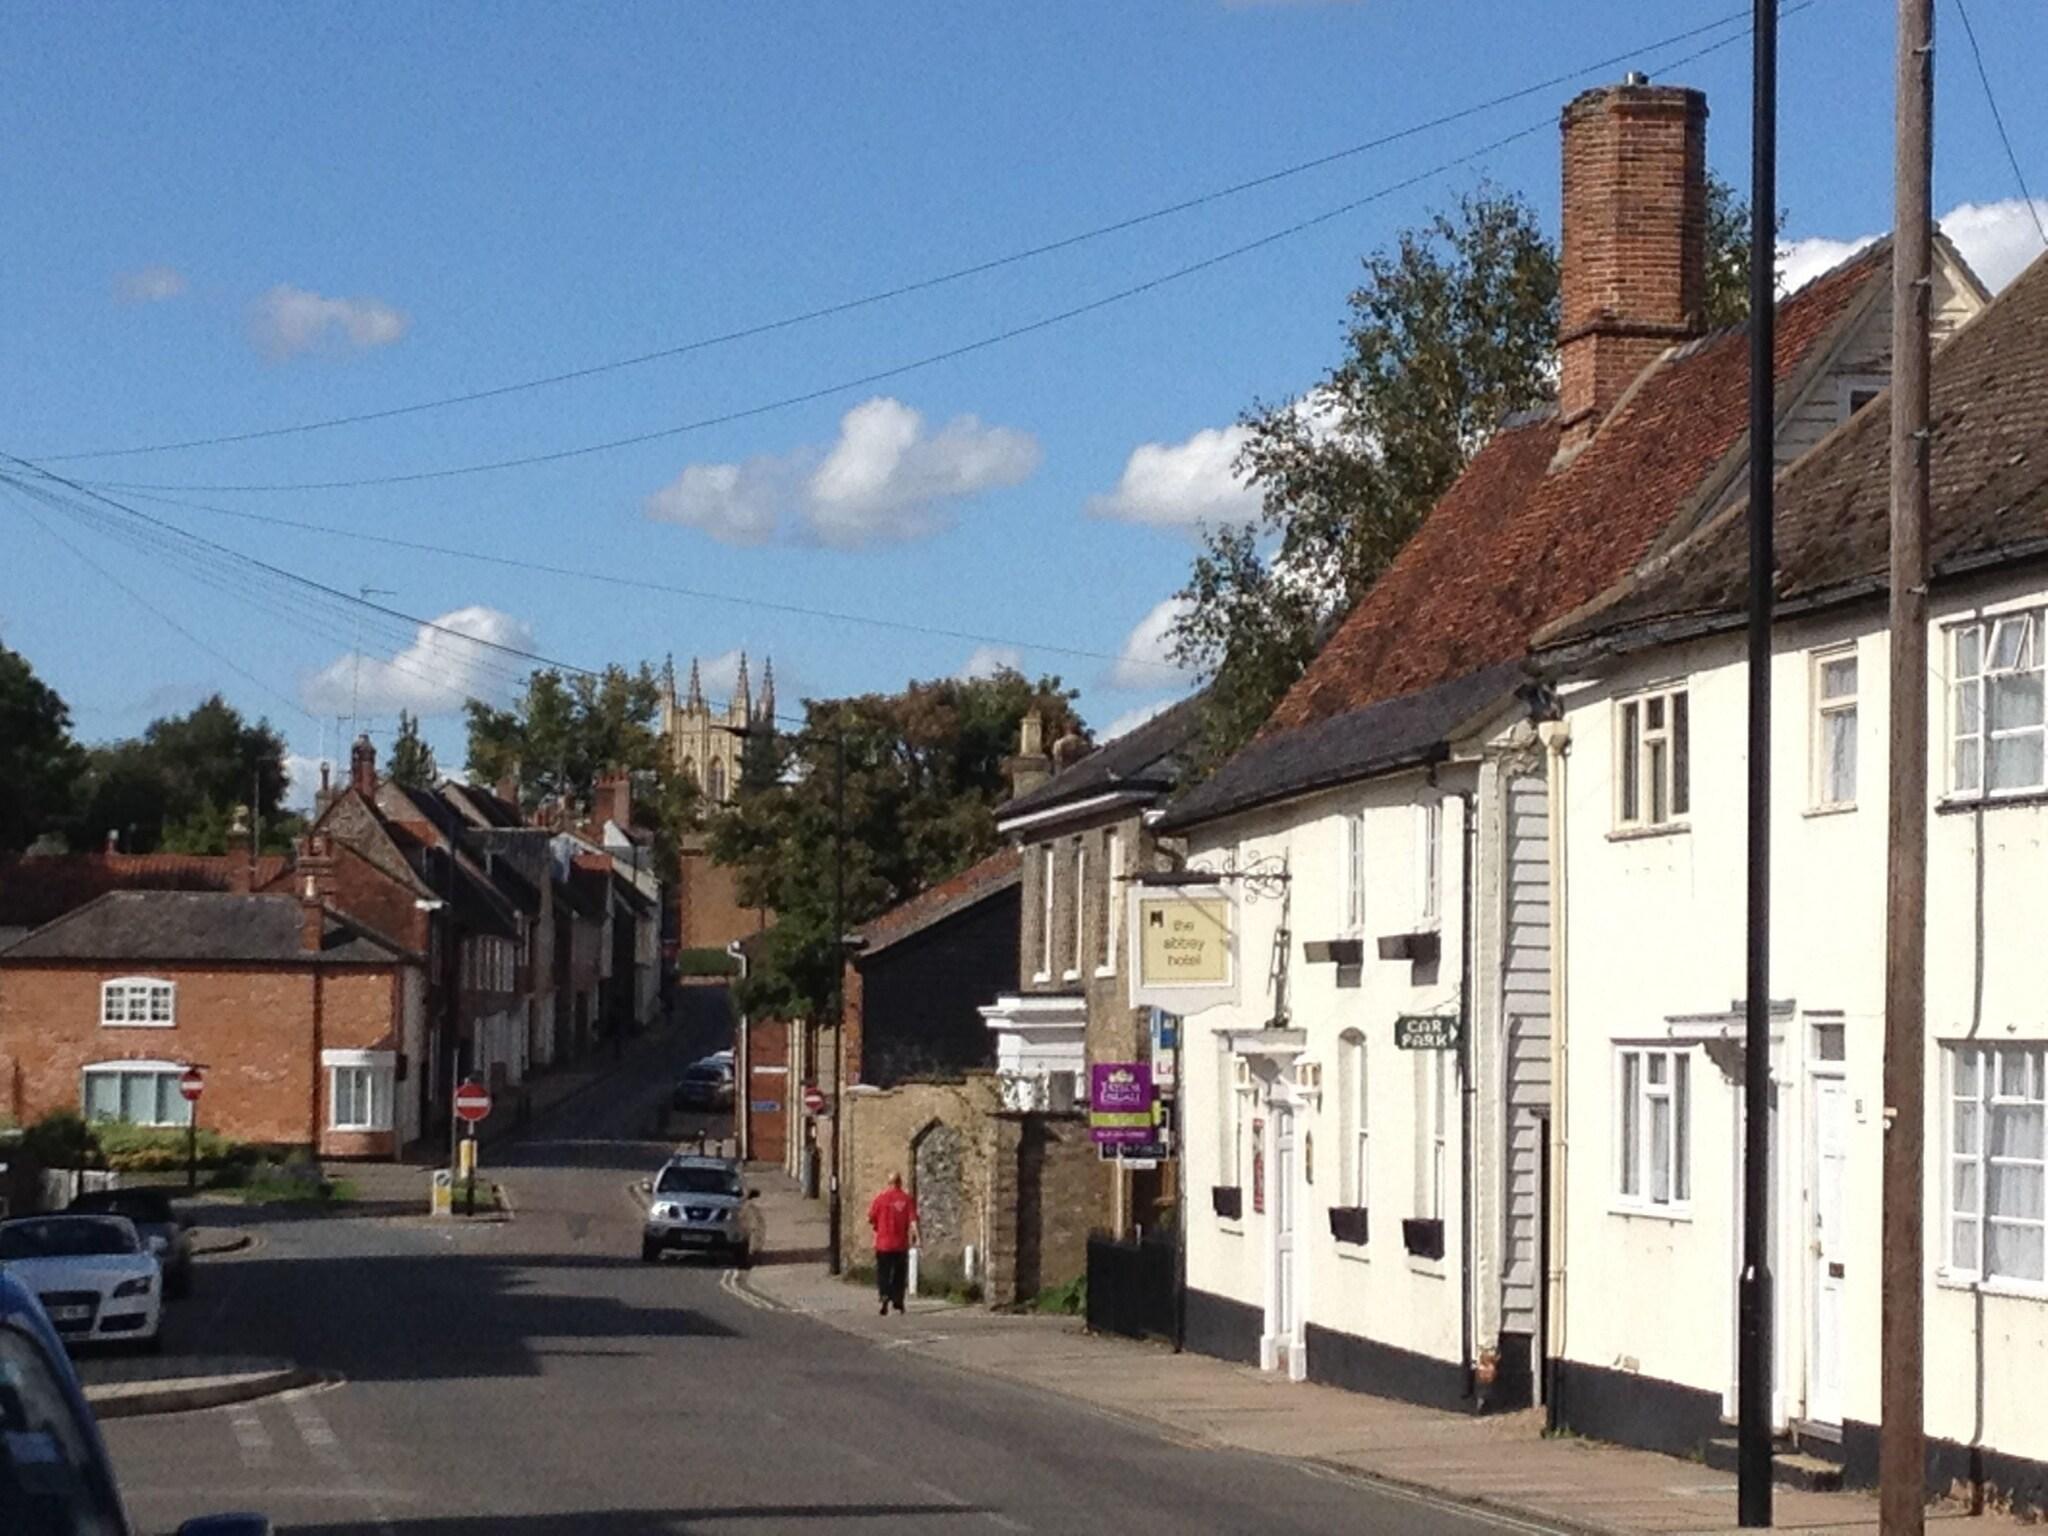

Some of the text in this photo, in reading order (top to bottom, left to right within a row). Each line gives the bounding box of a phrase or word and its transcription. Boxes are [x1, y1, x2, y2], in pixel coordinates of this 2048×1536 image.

[1173, 919, 1194, 932] the
[1163, 936, 1205, 952] abbey
[1167, 954, 1202, 966] hotel
[1407, 1019, 1442, 1033] CAR
[1402, 1033, 1447, 1047] PARK
